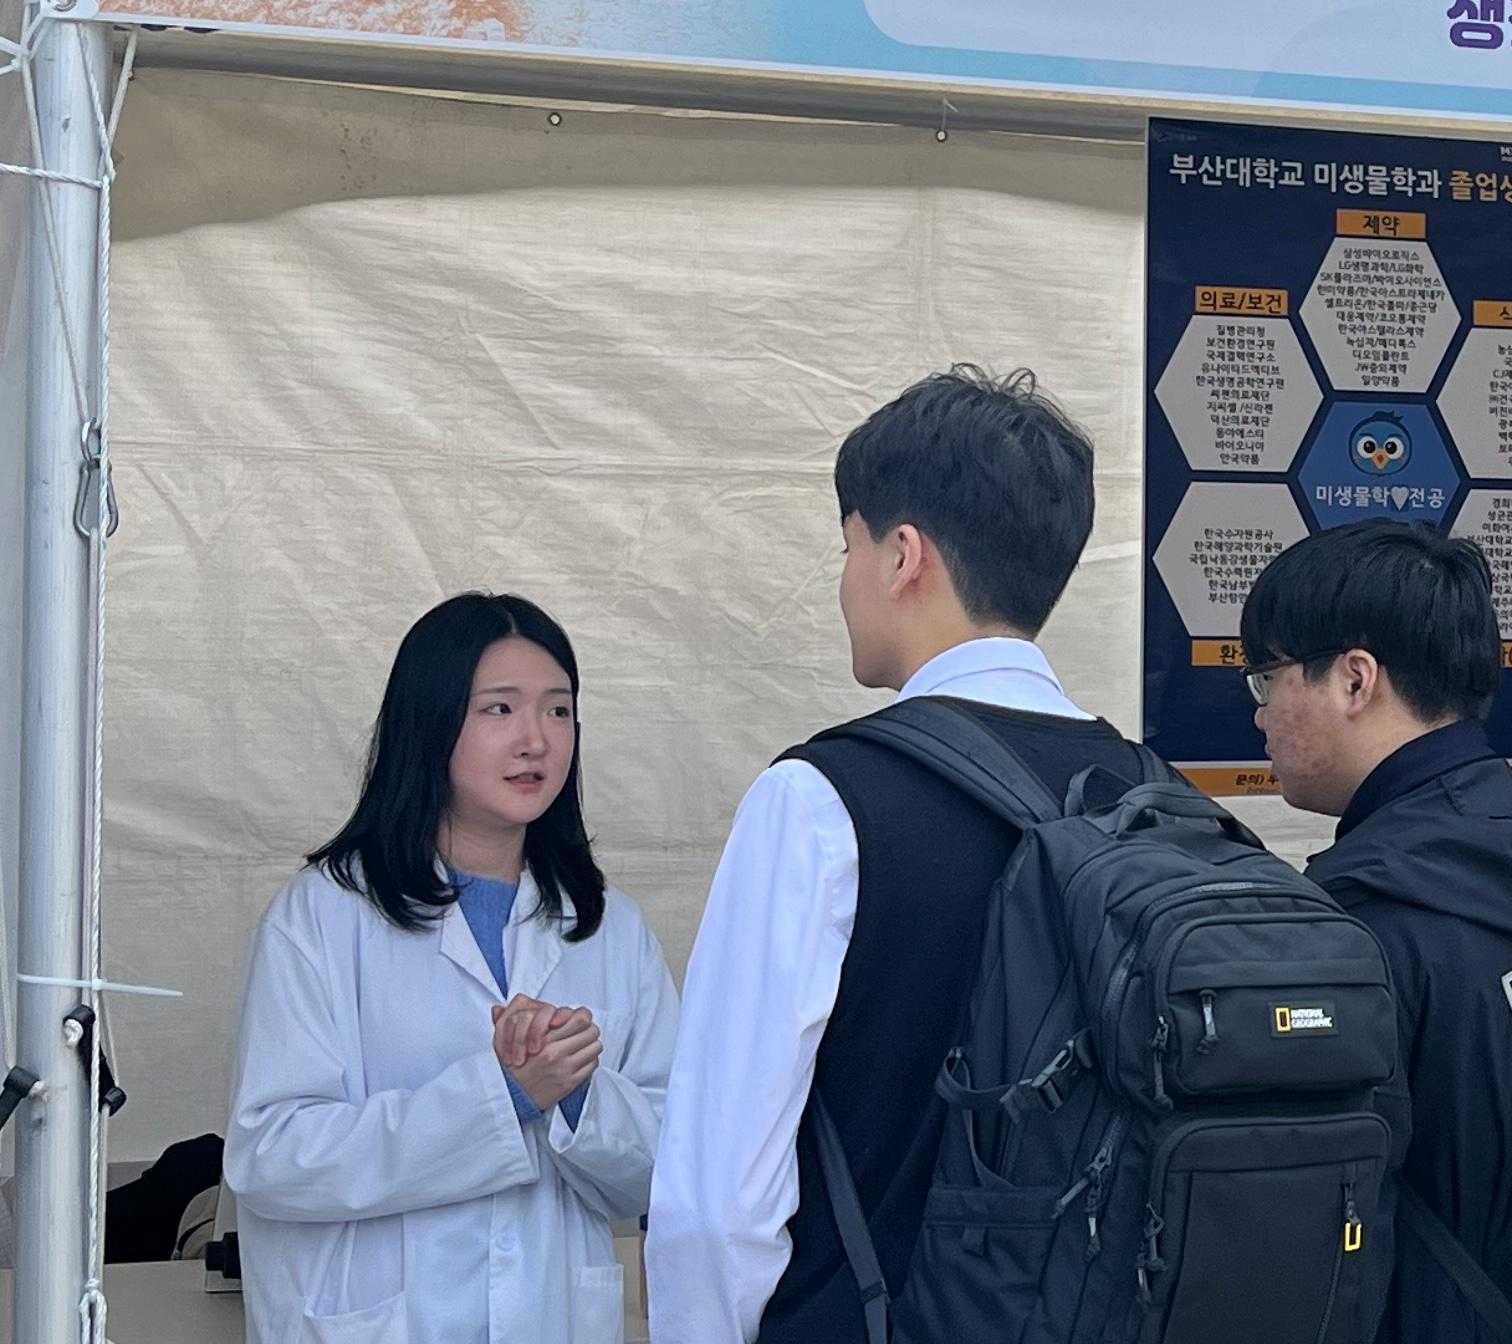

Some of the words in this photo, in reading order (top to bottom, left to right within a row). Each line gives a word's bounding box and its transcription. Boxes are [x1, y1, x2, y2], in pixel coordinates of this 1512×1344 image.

[1169, 154, 1305, 189] 부산대학교
[1313, 163, 1442, 198] 미생물학과
[1363, 215, 1400, 236] 제약
[1200, 291, 1281, 314] 의료/보건
